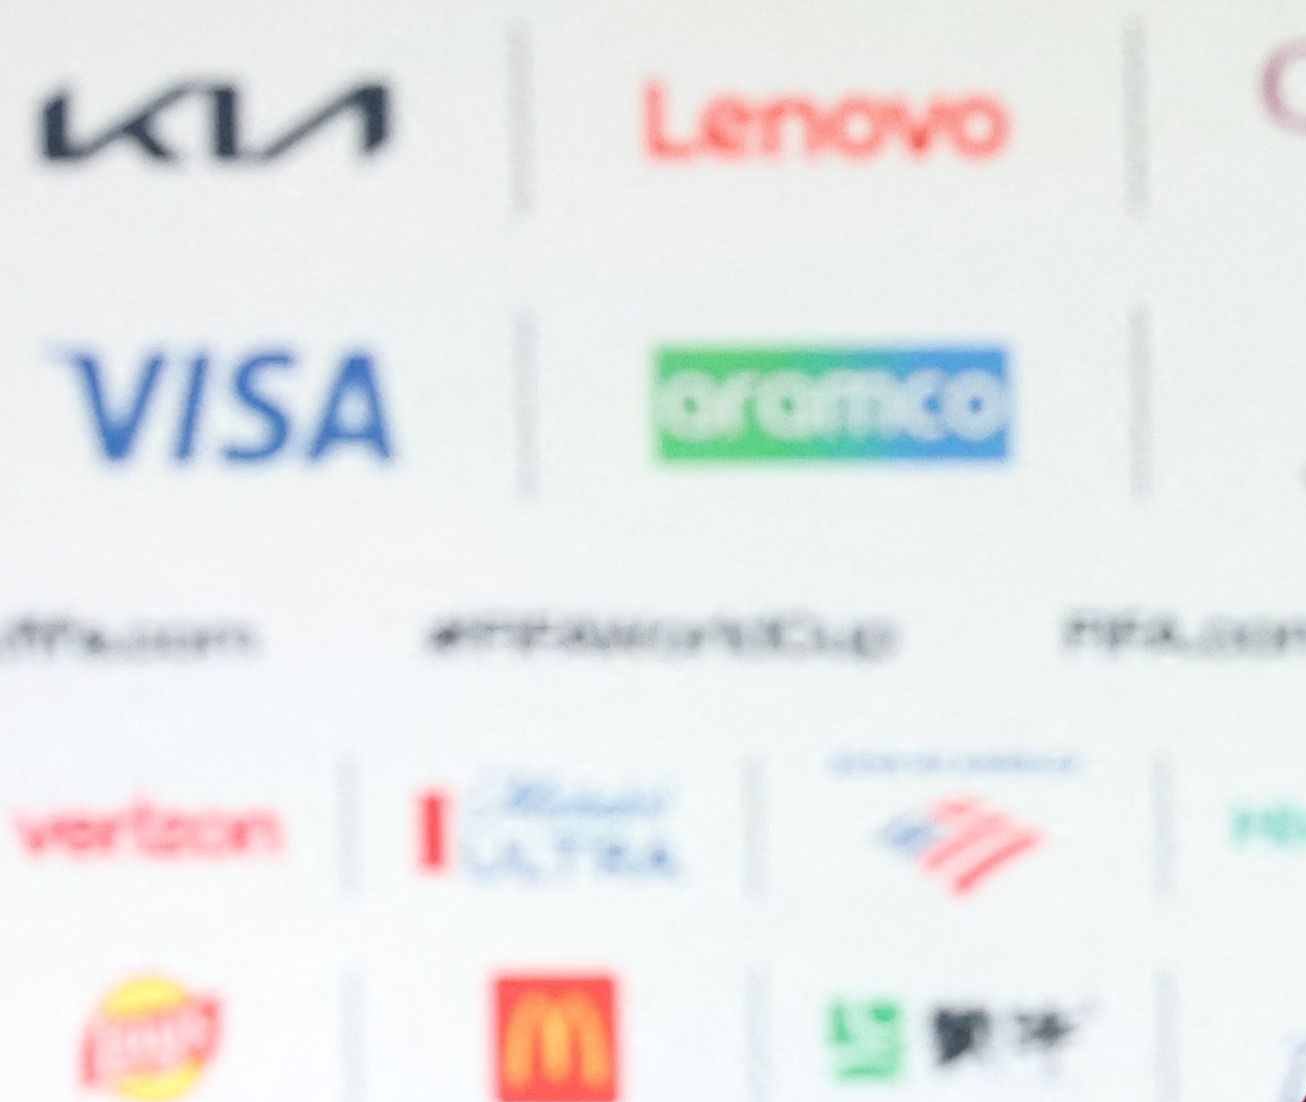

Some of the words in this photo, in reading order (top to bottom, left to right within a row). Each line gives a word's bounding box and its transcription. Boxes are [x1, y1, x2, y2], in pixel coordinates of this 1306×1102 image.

[643, 82, 1012, 162] Lenovo
[50, 346, 396, 466] VISA
[658, 366, 1004, 444] aramco
